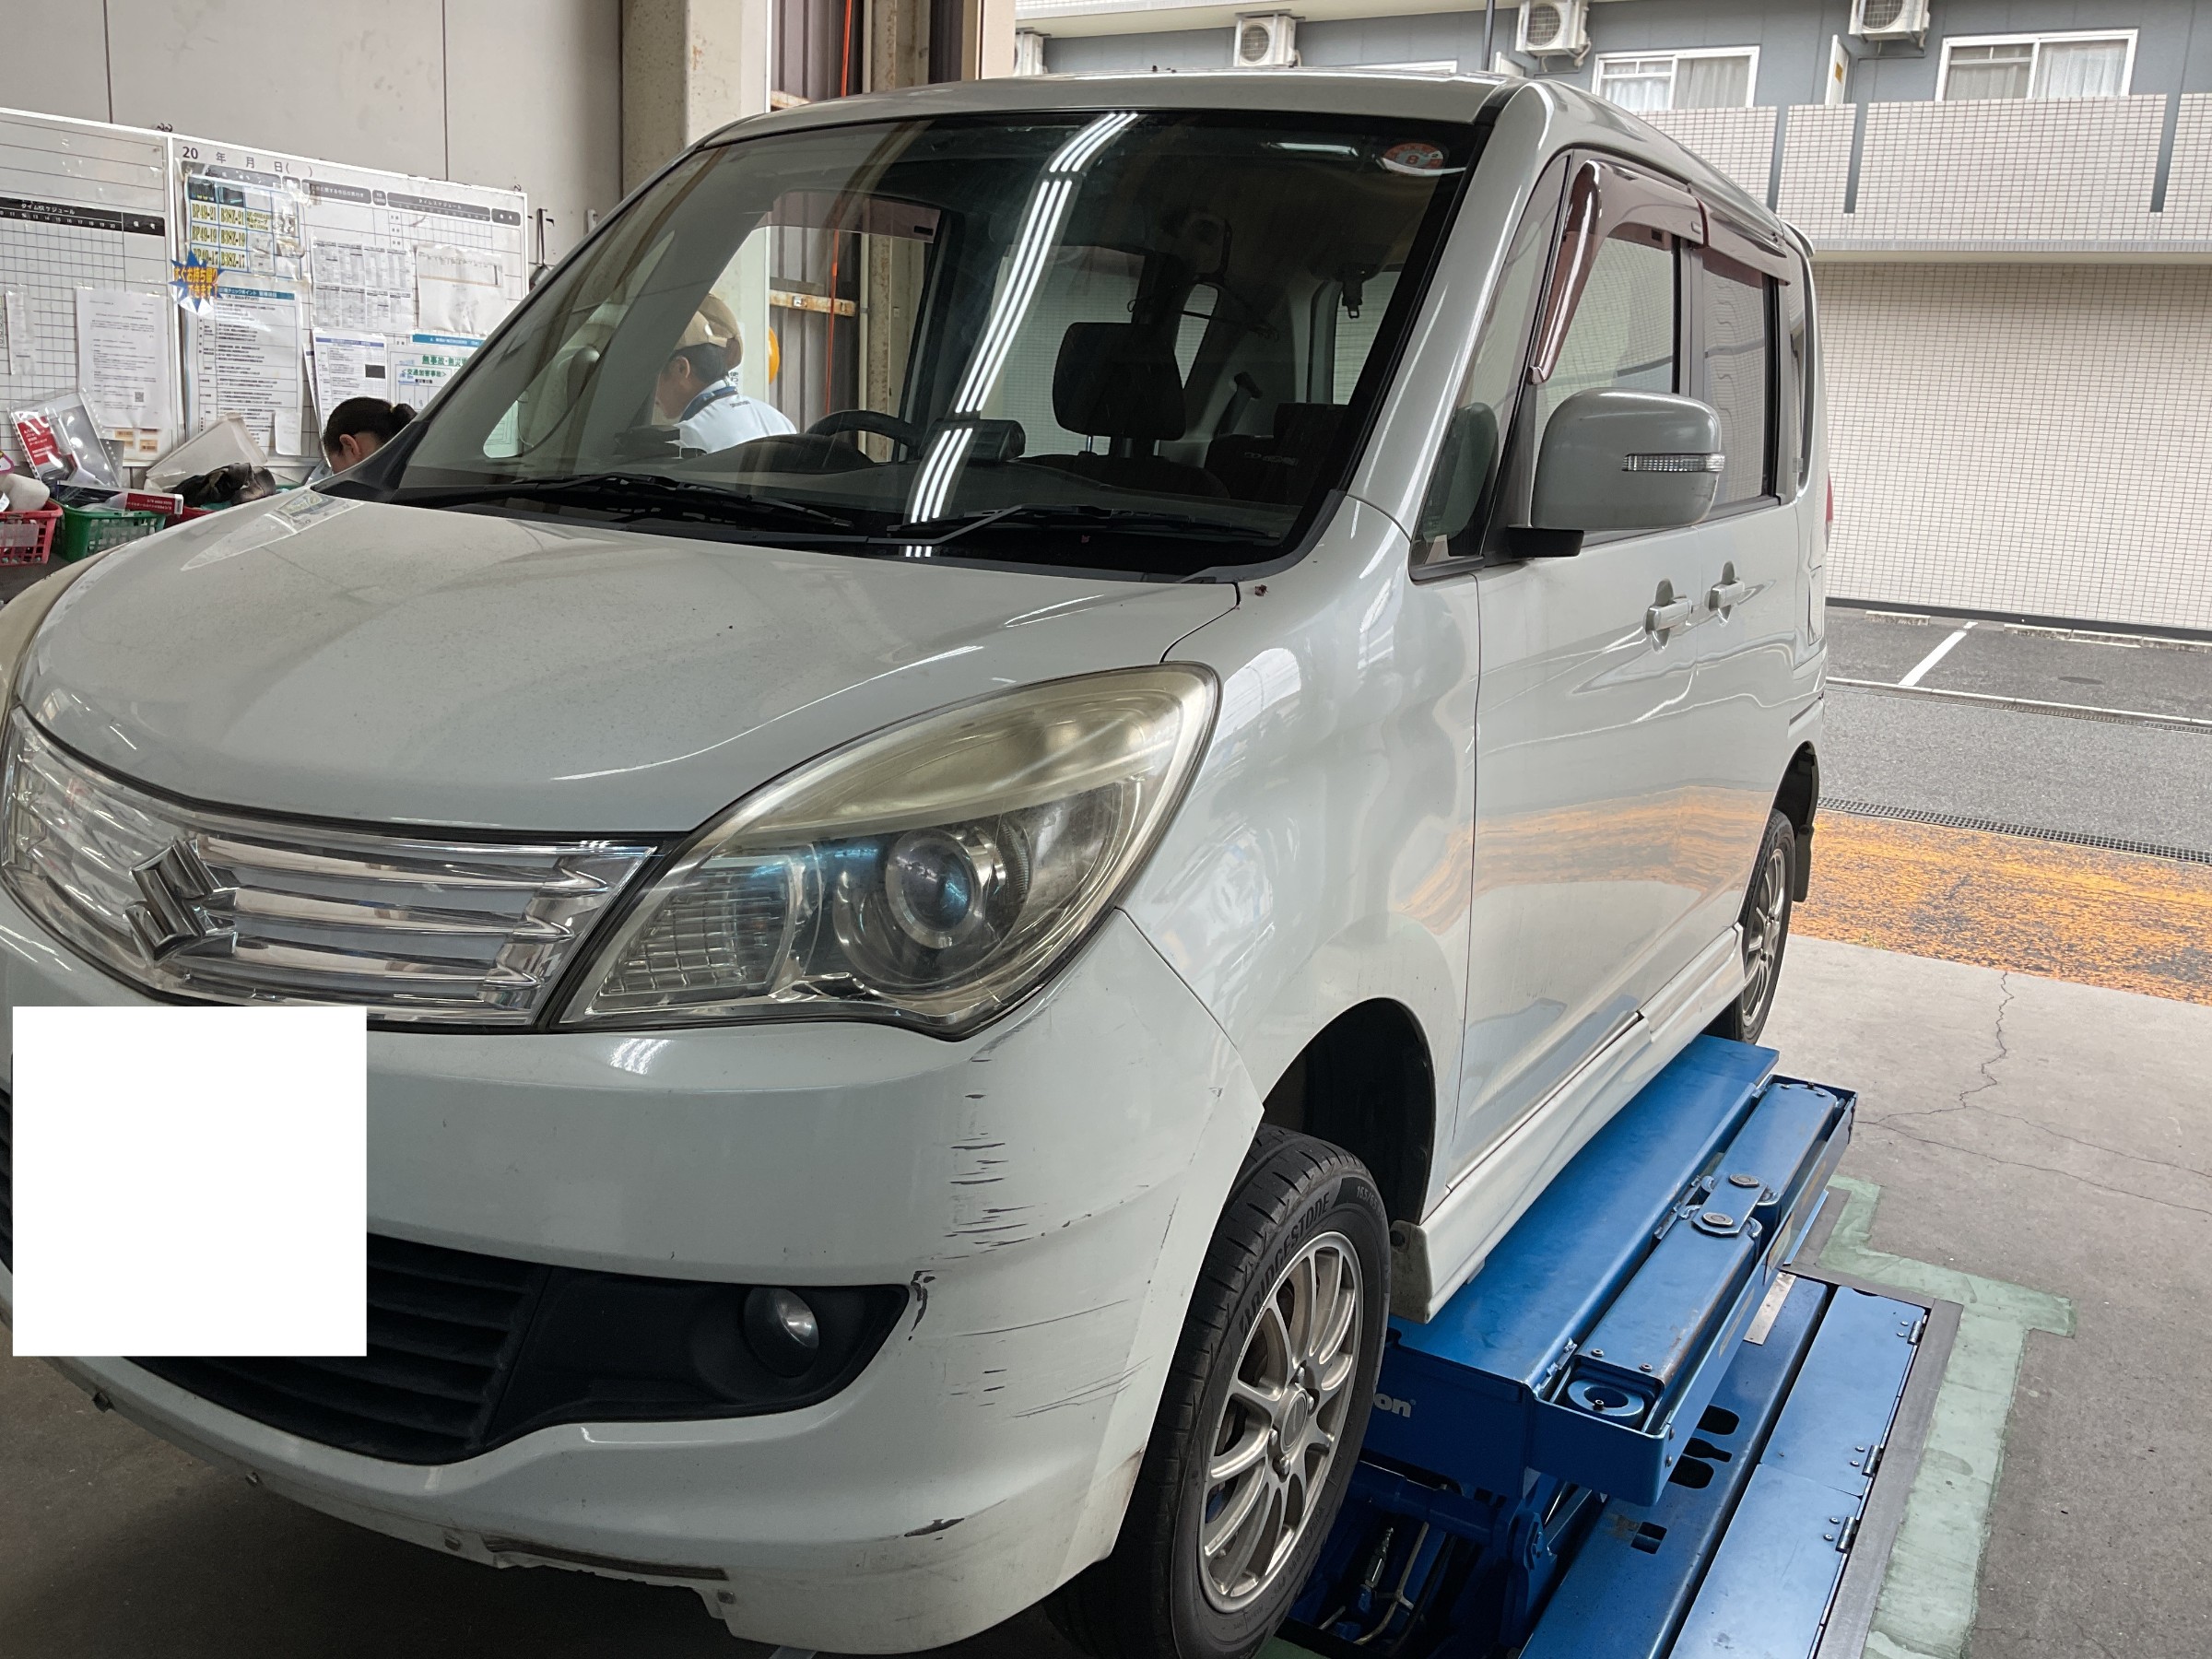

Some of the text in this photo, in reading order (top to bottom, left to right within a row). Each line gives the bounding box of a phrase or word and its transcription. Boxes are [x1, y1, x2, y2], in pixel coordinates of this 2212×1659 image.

[182, 147, 198, 159] 20
[216, 152, 226, 163] 年
[246, 157, 254, 168] 月
[1239, 1192, 1330, 1339] BRIDGESTONE
